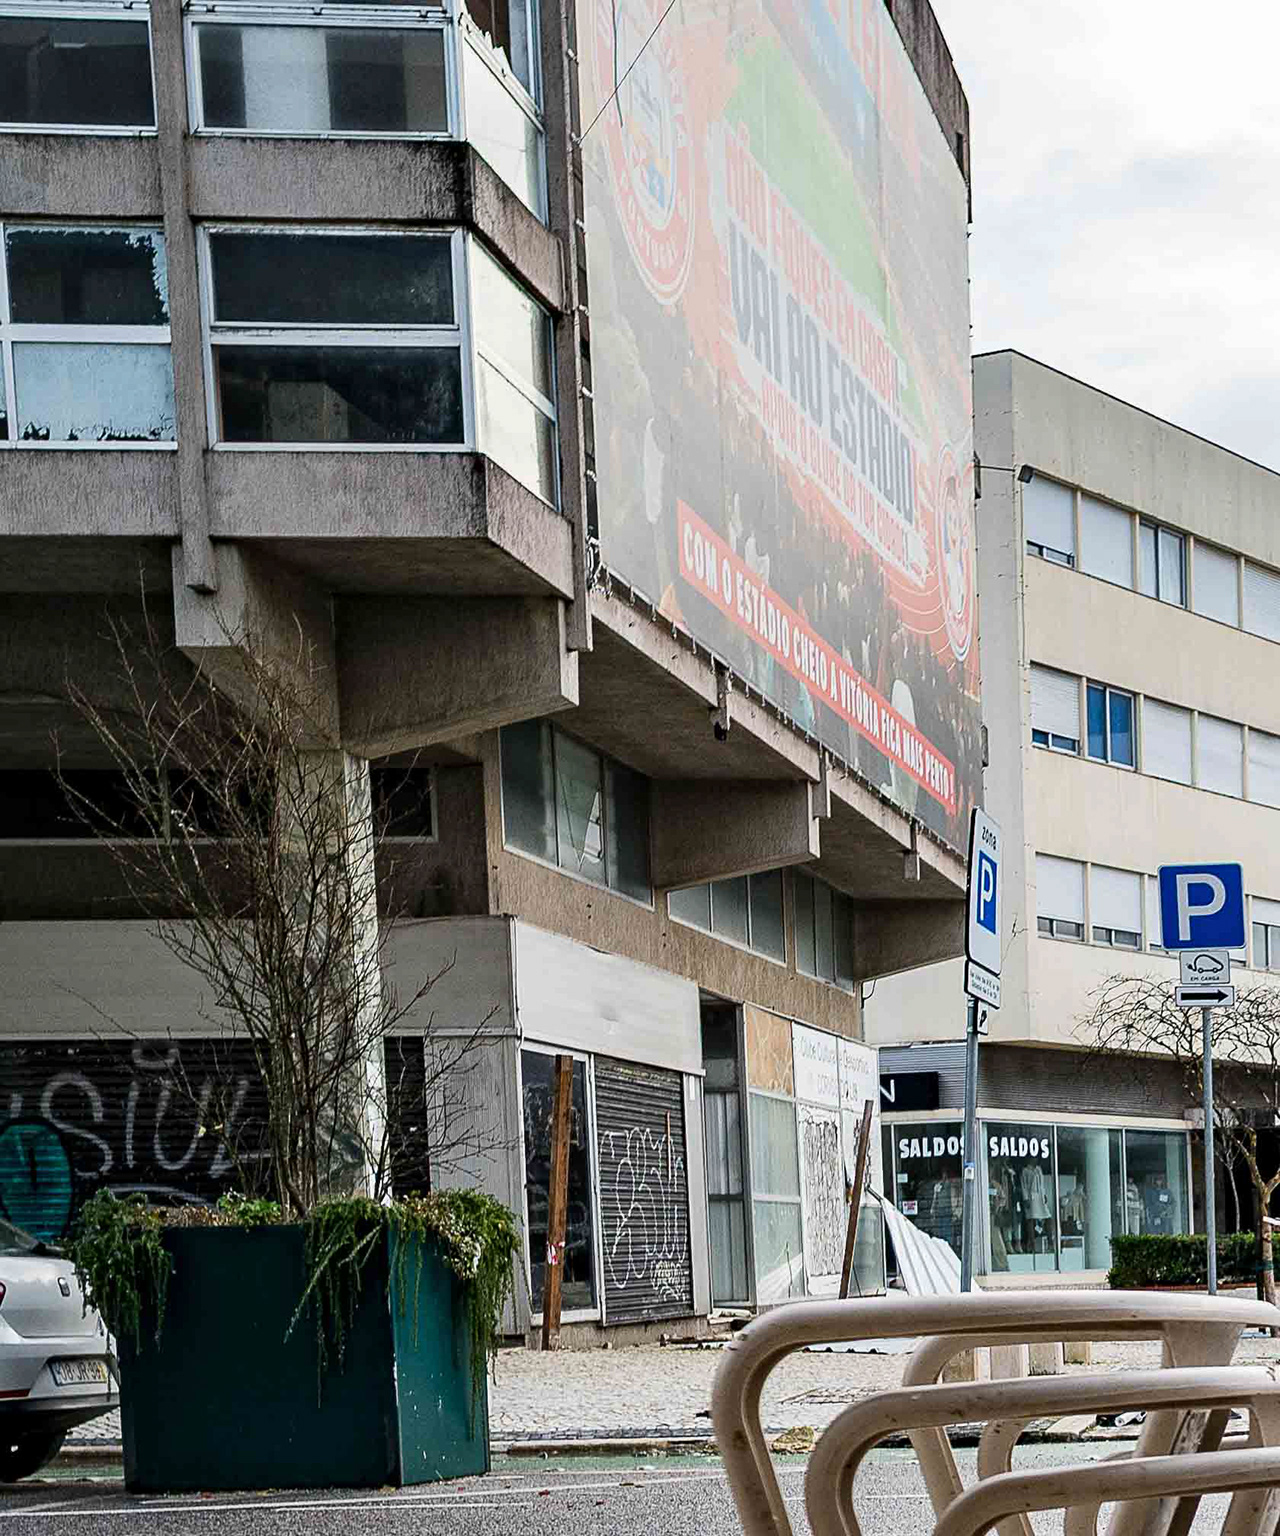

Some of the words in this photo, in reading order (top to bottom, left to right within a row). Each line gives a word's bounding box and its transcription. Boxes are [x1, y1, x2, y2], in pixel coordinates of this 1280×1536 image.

[729, 217, 782, 388] VAI
[786, 291, 824, 429] AO
[683, 522, 718, 595] COM
[722, 558, 732, 605] O
[735, 571, 790, 658] ESTÁDIO
[792, 626, 828, 692] CHEIO
[830, 662, 838, 702] A
[839, 669, 880, 739] VITÓRIA
[881, 708, 901, 758] FICA
[902, 722, 924, 775] MAIS
[981, 826, 997, 850] zona
[980, 858, 994, 922] P
[1175, 873, 1226, 941] P
[989, 1136, 1050, 1159] SALDOS
